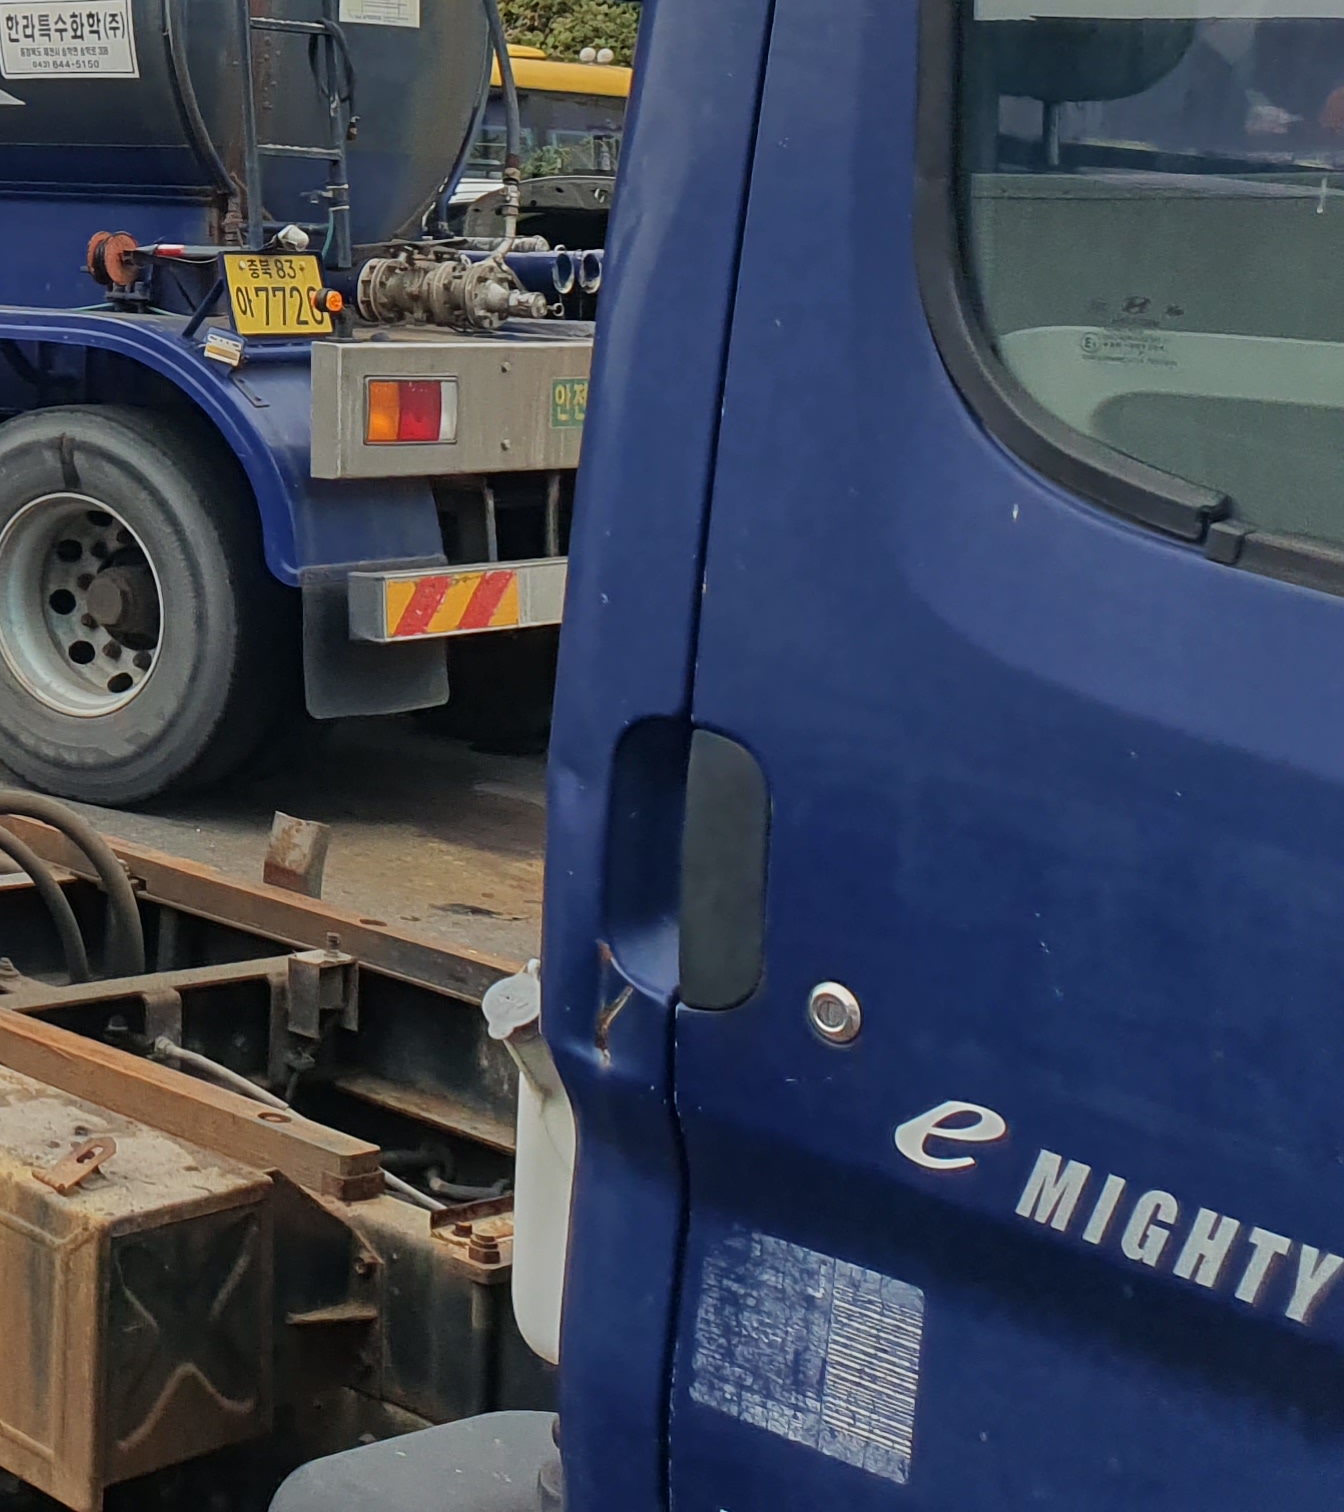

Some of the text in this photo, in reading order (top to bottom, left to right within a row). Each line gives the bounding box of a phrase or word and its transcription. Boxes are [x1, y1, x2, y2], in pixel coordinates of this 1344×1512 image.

[6, 10, 125, 44] 한라특수화학(주)
[52, 59, 100, 69] 644-5150
[247, 258, 297, 279] 충북 83
[894, 1100, 1344, 1324] e MIGHTY
